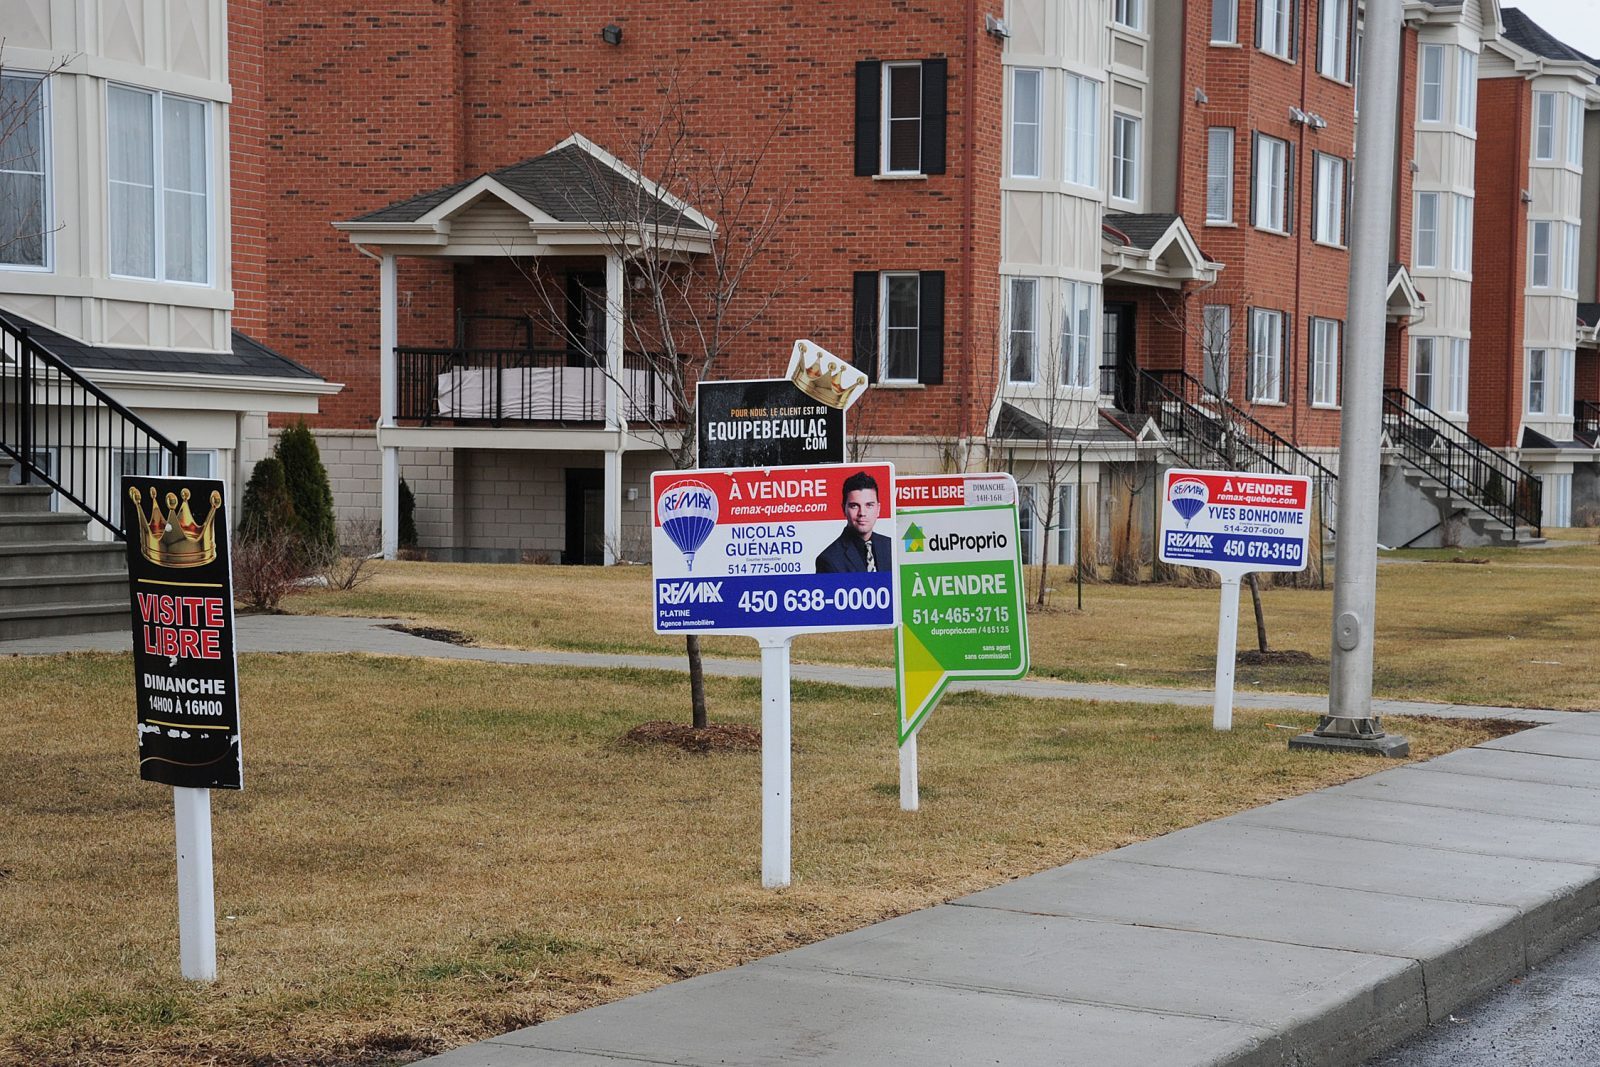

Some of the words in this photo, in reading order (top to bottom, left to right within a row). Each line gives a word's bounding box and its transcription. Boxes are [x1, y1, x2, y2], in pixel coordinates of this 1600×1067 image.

[731, 409, 748, 418] POUR
[750, 408, 769, 418] NOUS,
[770, 408, 778, 417] LE
[780, 407, 801, 416] CLIENT
[803, 406, 814, 416] EST
[816, 406, 827, 415] ROI
[708, 418, 827, 441] EQUIPEBEAULAC
[803, 438, 827, 450] .COM
[729, 478, 743, 500] À
[747, 479, 828, 499] VENDRE
[932, 485, 964, 499] LIBRE
[973, 483, 1006, 492] DIMANCHE
[1173, 485, 1204, 497] RE/MAX
[1223, 479, 1233, 493] À
[1236, 482, 1293, 496] VENDRE
[665, 490, 711, 512] RE/MAX
[976, 494, 1002, 502] 14H-16H
[1217, 493, 1298, 505] remax-quebec.com
[730, 502, 828, 517] remax-quebec.com
[1208, 506, 1236, 521] YVES
[1239, 508, 1303, 525] BONHOMME
[731, 525, 796, 540] NICOLAS
[1223, 524, 1285, 535] 514-207-6000
[725, 539, 803, 556] GUÉNARD
[928, 531, 1007, 553] duProprio
[1167, 532, 1214, 549] RE/MAX
[1223, 539, 1244, 557] 450
[1248, 541, 1301, 560] 678-3150
[728, 563, 747, 575] 514
[750, 562, 801, 573] 775-0003
[659, 581, 724, 605] RE/MAX
[911, 573, 926, 597] À
[928, 573, 1007, 596] VENDRE
[738, 590, 778, 613] 450
[783, 587, 890, 612] 638-0000
[137, 592, 225, 628] VISITE
[660, 609, 691, 618] PLATINE
[660, 620, 682, 628] Agence
[931, 626, 977, 637] duproprio.com
[143, 624, 221, 659] LIBRE
[144, 672, 226, 695] DIMANCHE
[149, 696, 173, 715] 14H00
[175, 695, 183, 715] À
[185, 699, 223, 716] 16H00
